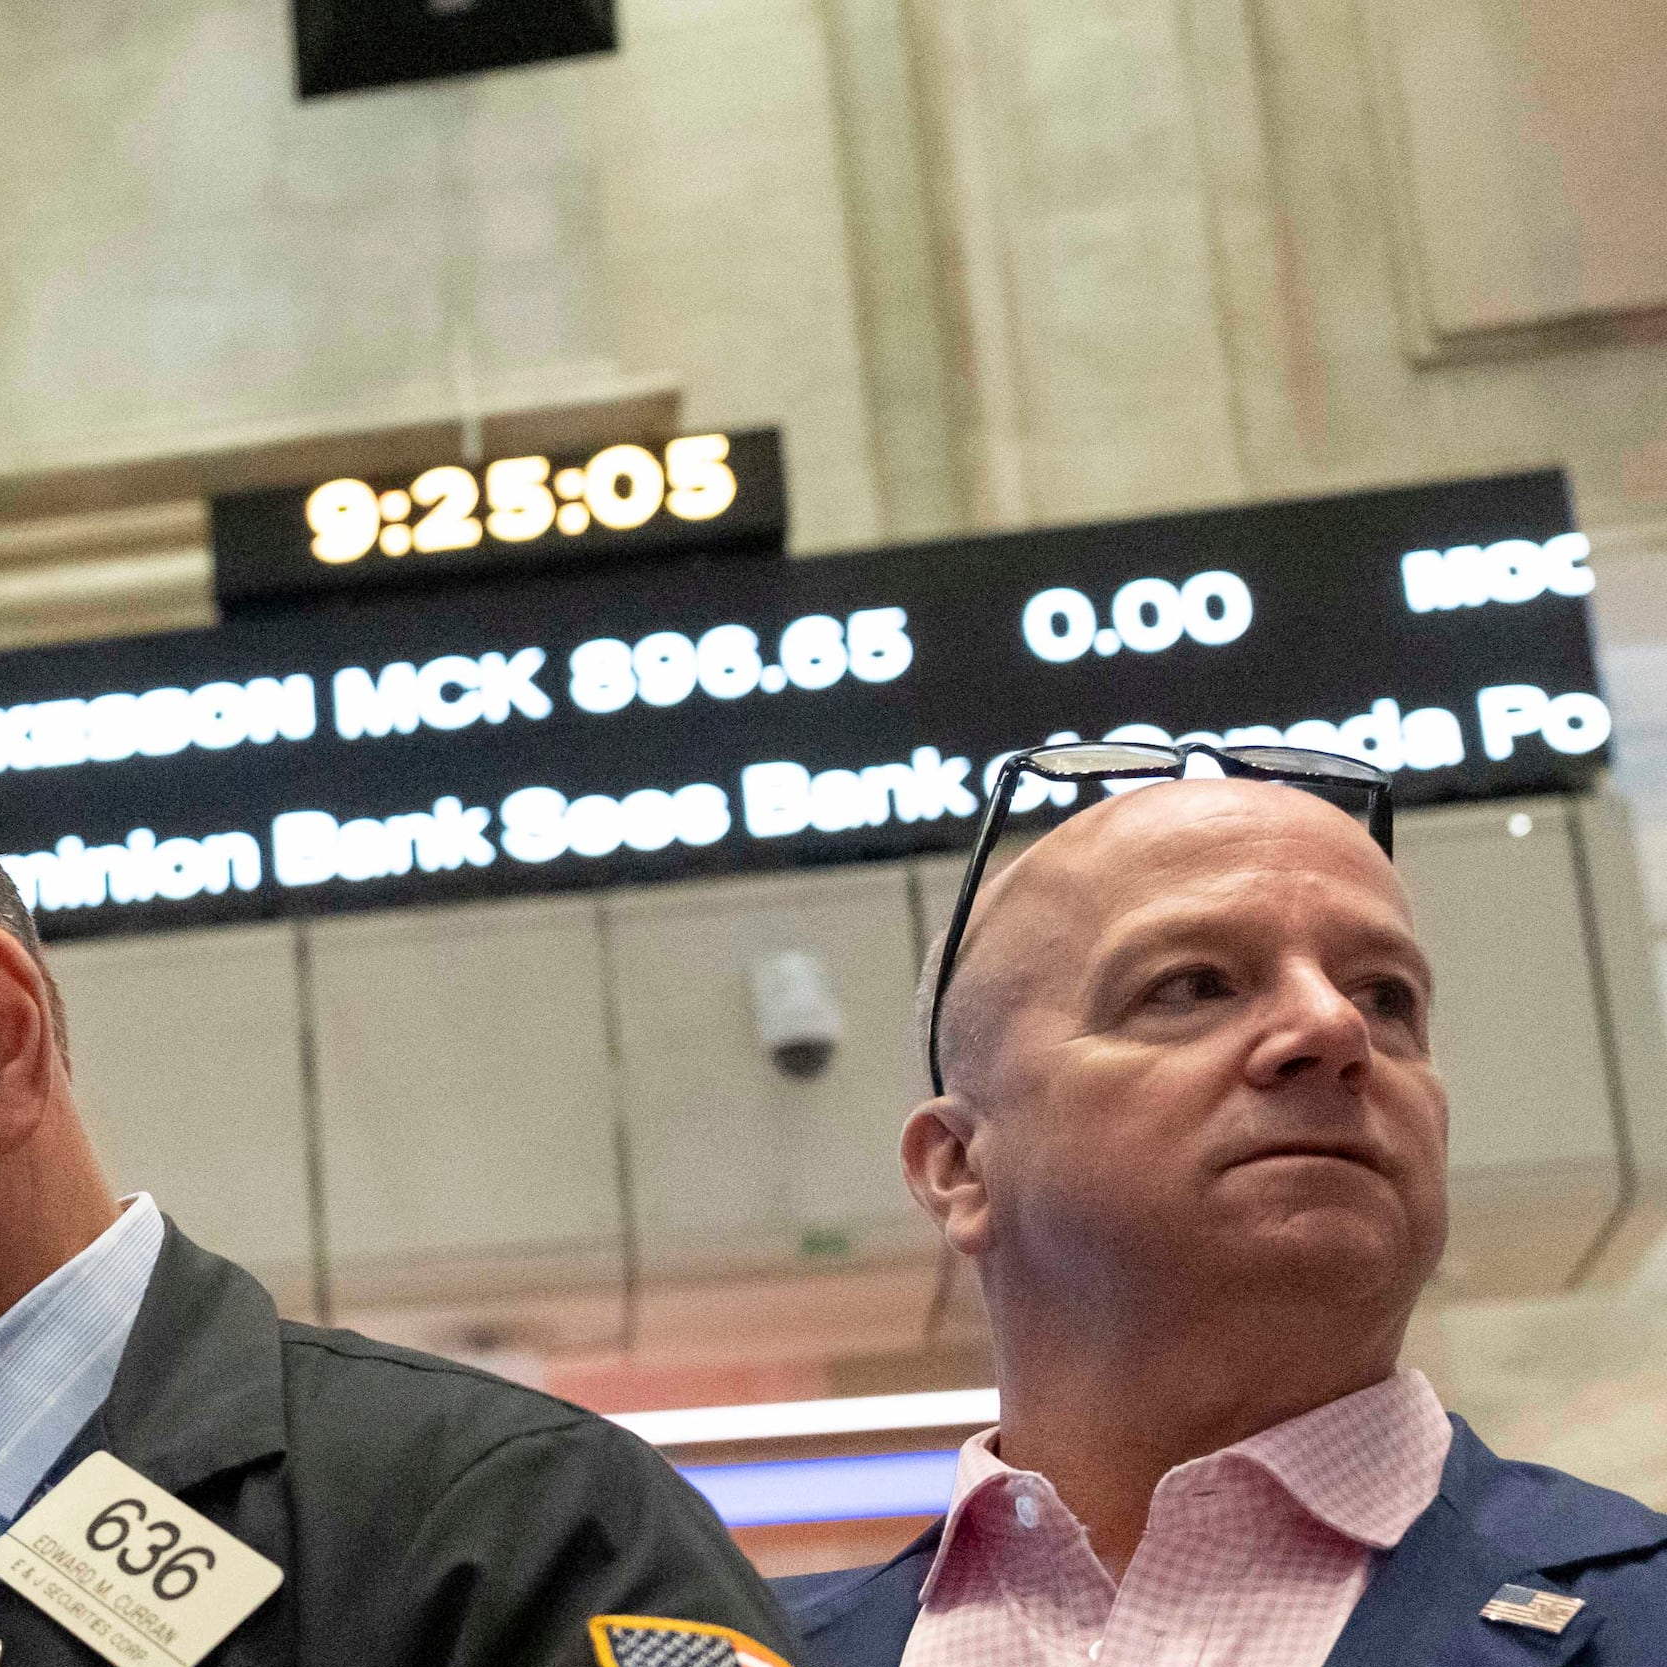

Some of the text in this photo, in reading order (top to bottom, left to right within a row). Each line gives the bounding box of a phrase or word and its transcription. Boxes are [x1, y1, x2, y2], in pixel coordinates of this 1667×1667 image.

[305, 433, 737, 564] 9:25:05
[333, 648, 553, 740] MCK
[570, 607, 913, 713] 896.65
[1022, 570, 1254, 663] 0.00
[272, 796, 497, 887] Bank
[500, 783, 731, 864] Sees
[741, 746, 978, 839] Bank
[32, 1534, 97, 1584] EDWARD
[114, 1594, 179, 1645] CURRAN
[84, 1497, 217, 1601] 636
